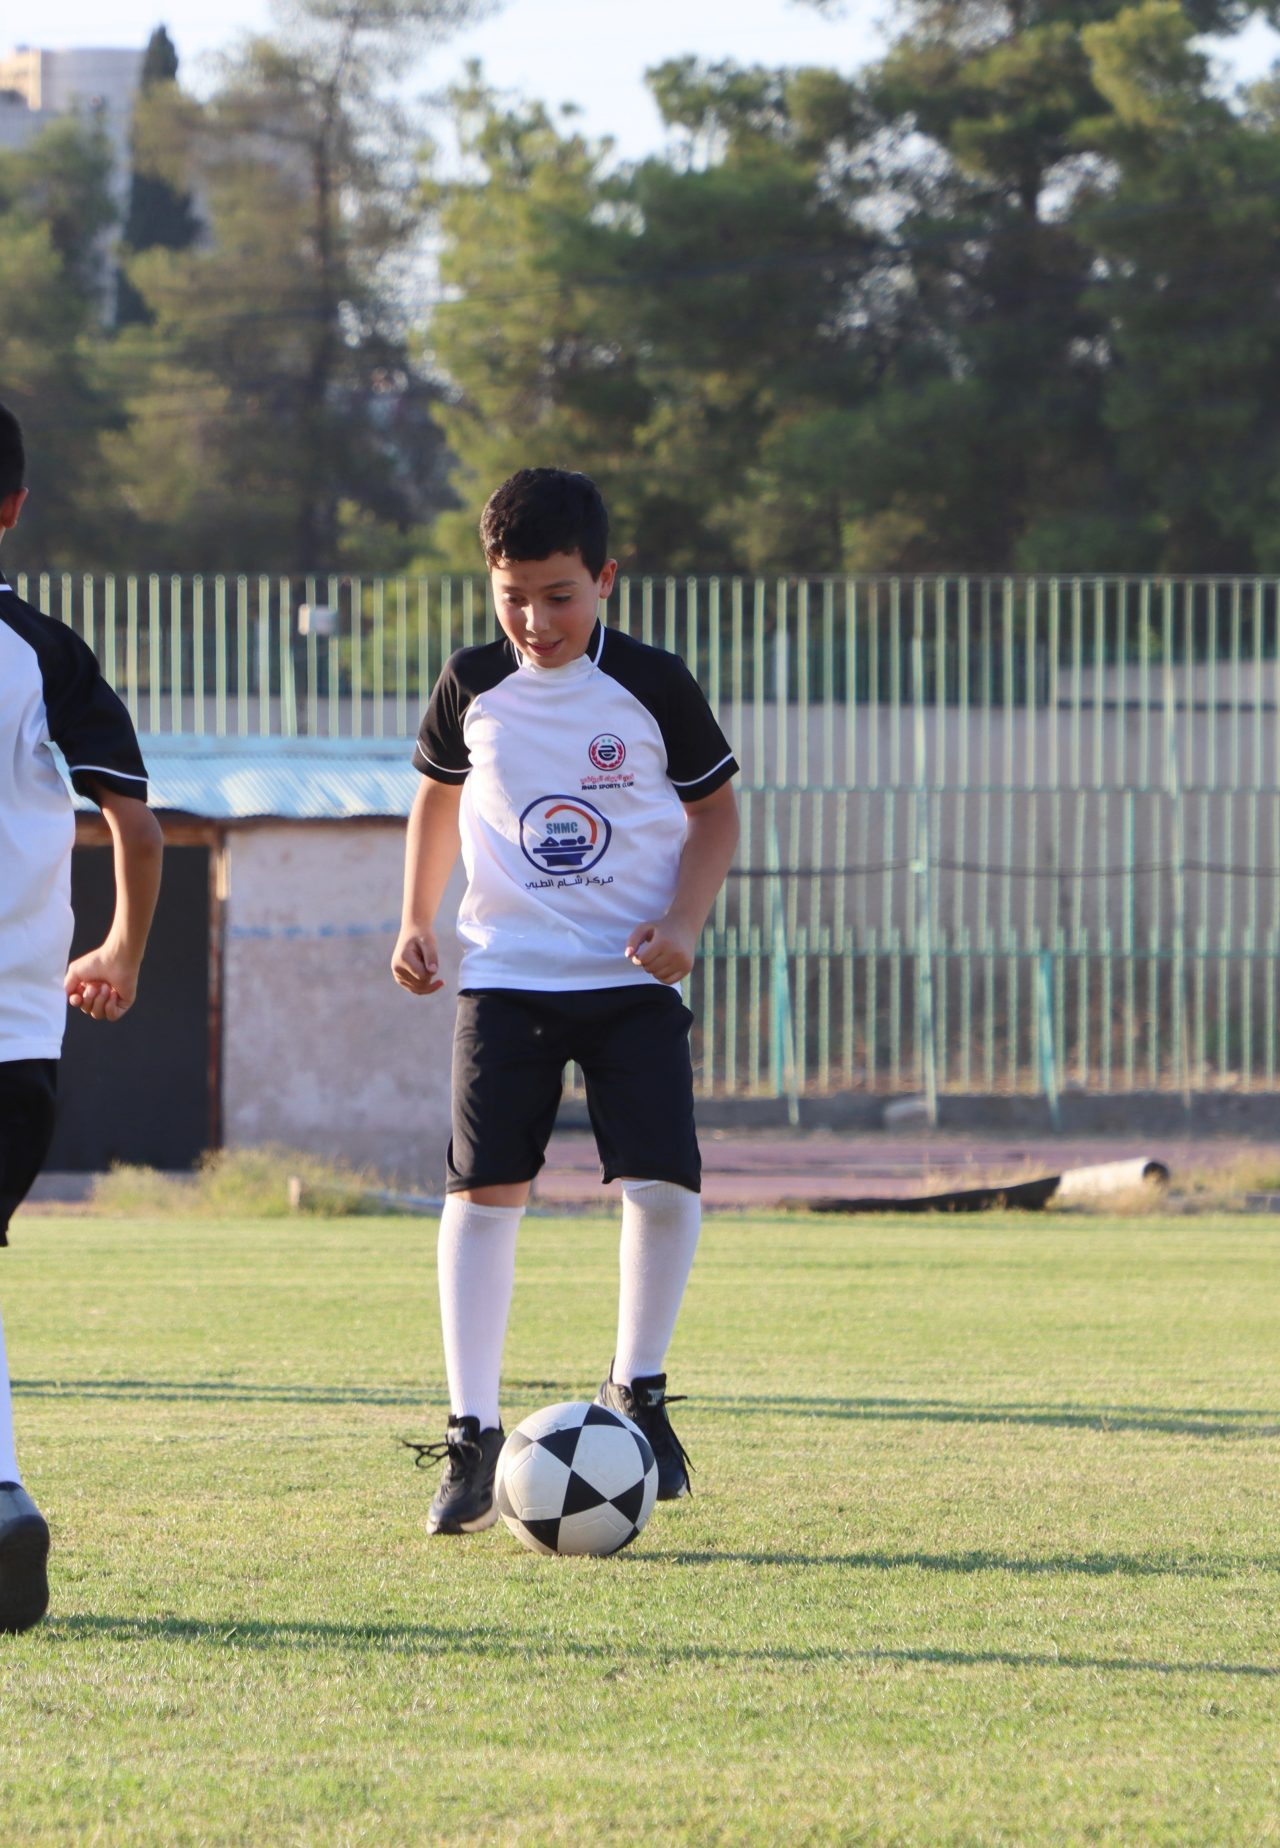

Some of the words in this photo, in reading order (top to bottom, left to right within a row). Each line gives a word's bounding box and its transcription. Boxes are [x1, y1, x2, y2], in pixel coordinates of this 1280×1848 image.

[546, 822, 578, 835] SHMC
[525, 879, 554, 890] الطبي
[557, 874, 583, 889] شام
[585, 875, 614, 886] مركز
